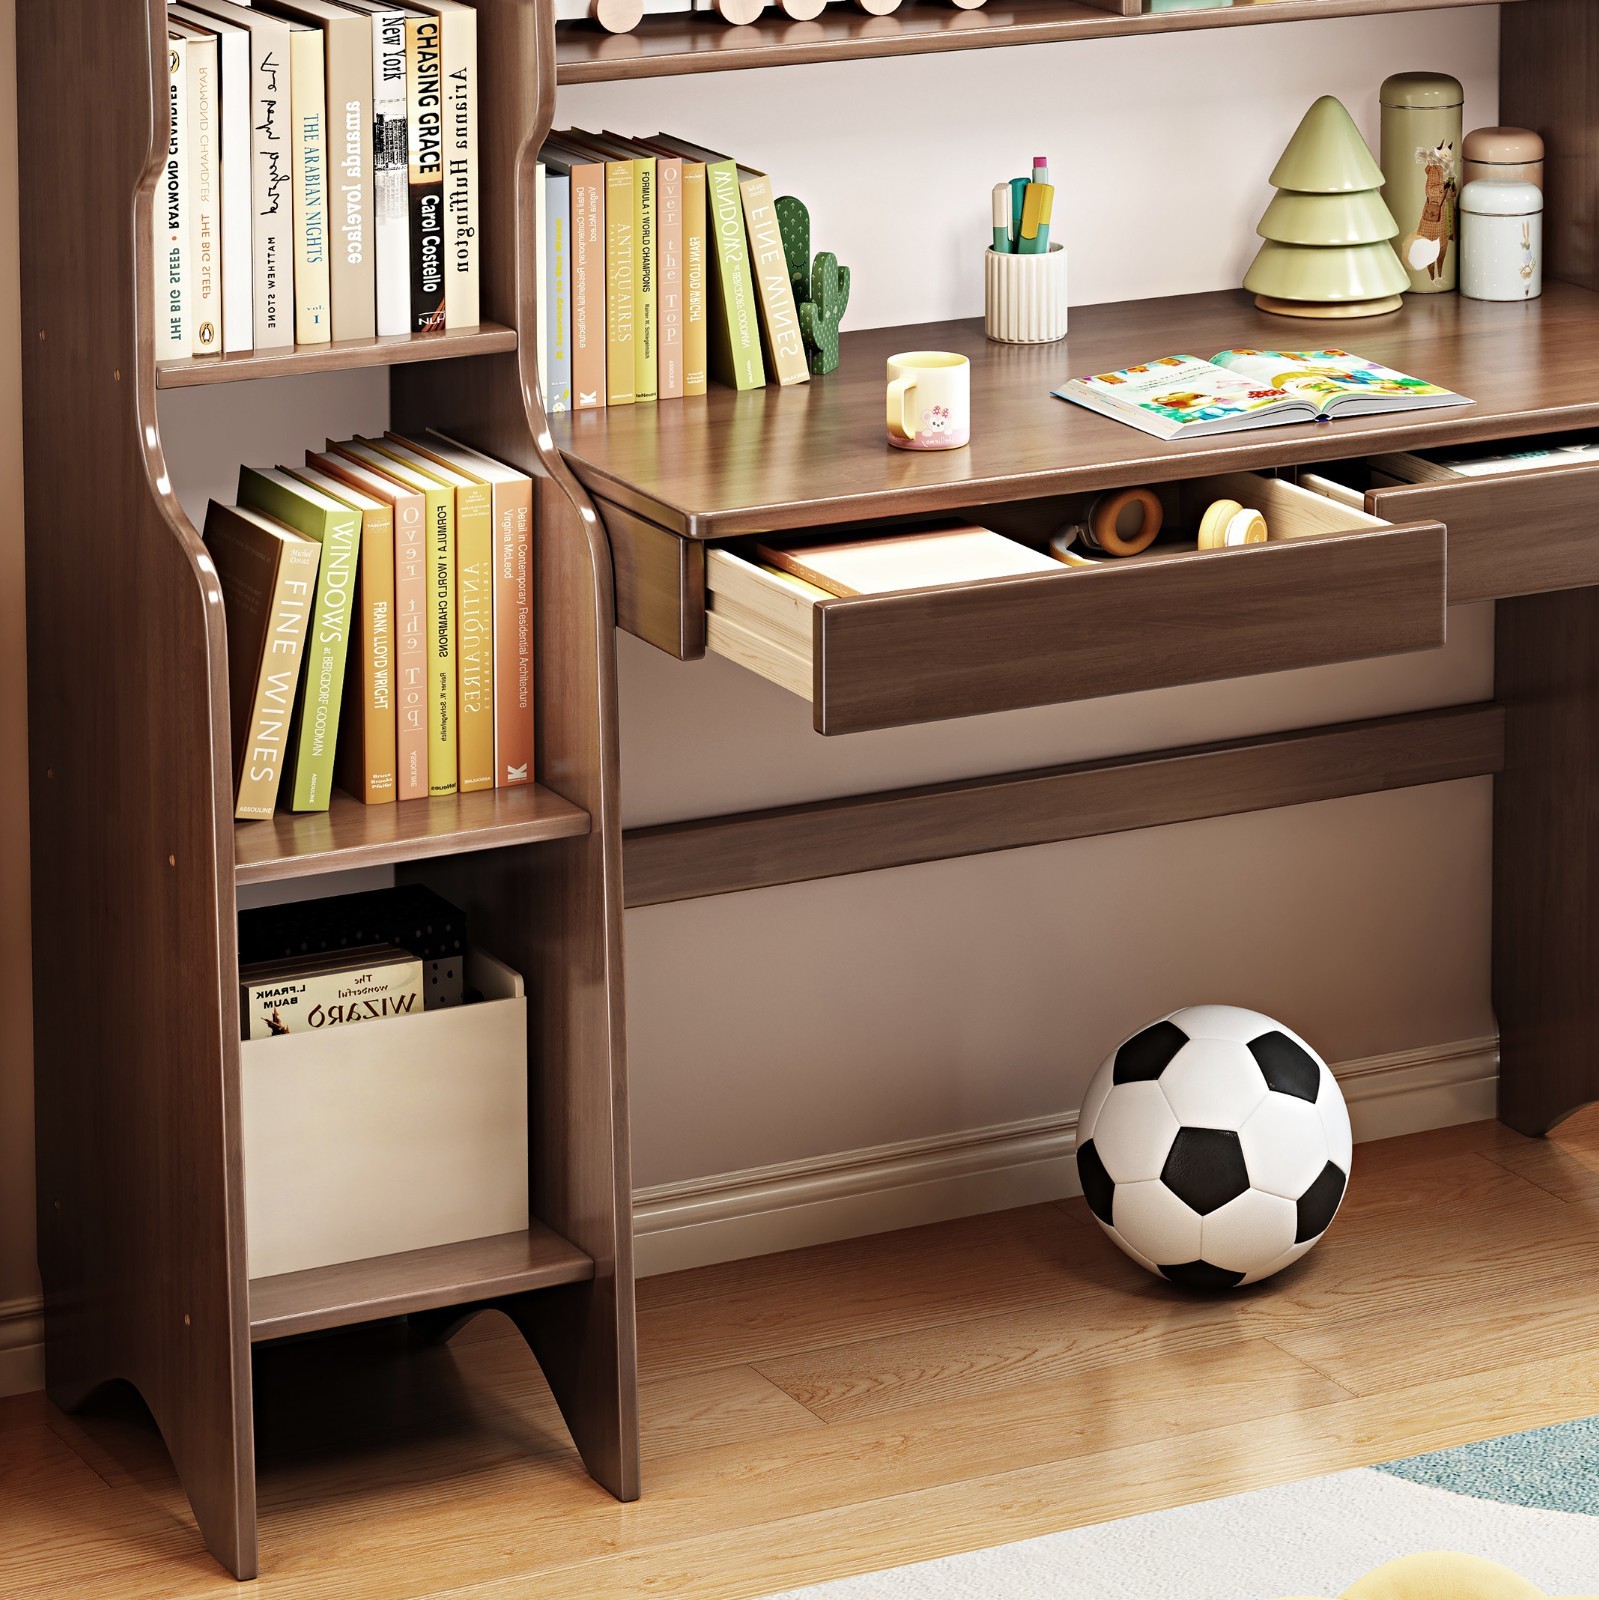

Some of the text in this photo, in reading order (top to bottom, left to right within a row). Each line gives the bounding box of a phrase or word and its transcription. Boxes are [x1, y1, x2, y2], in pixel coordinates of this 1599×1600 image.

[383, 17, 406, 82] New York
[416, 22, 440, 174] CHASING GRACE
[303, 114, 322, 264] THE ARABIAN NIGHTS
[642, 172, 650, 209] FORMULA
[642, 216, 650, 246] WORLD
[420, 194, 442, 293] Carol Costello
[614, 224, 632, 342] ANTIQUAIRES
[664, 168, 677, 342] Over the Top
[320, 520, 354, 643] WINDOWS
[502, 508, 514, 579] Virginia McLeod
[374, 602, 388, 710] FRANK LLOYD WRIGHT
[516, 508, 528, 708] Detail in Contemporary Residential Architecture
[250, 580, 308, 782] FINE WINES
[318, 656, 334, 705] BERGDORF
[312, 706, 328, 756] GOODMAN
[240, 806, 272, 814] ASSOULINE
[309, 774, 317, 804] ASSOULINE
